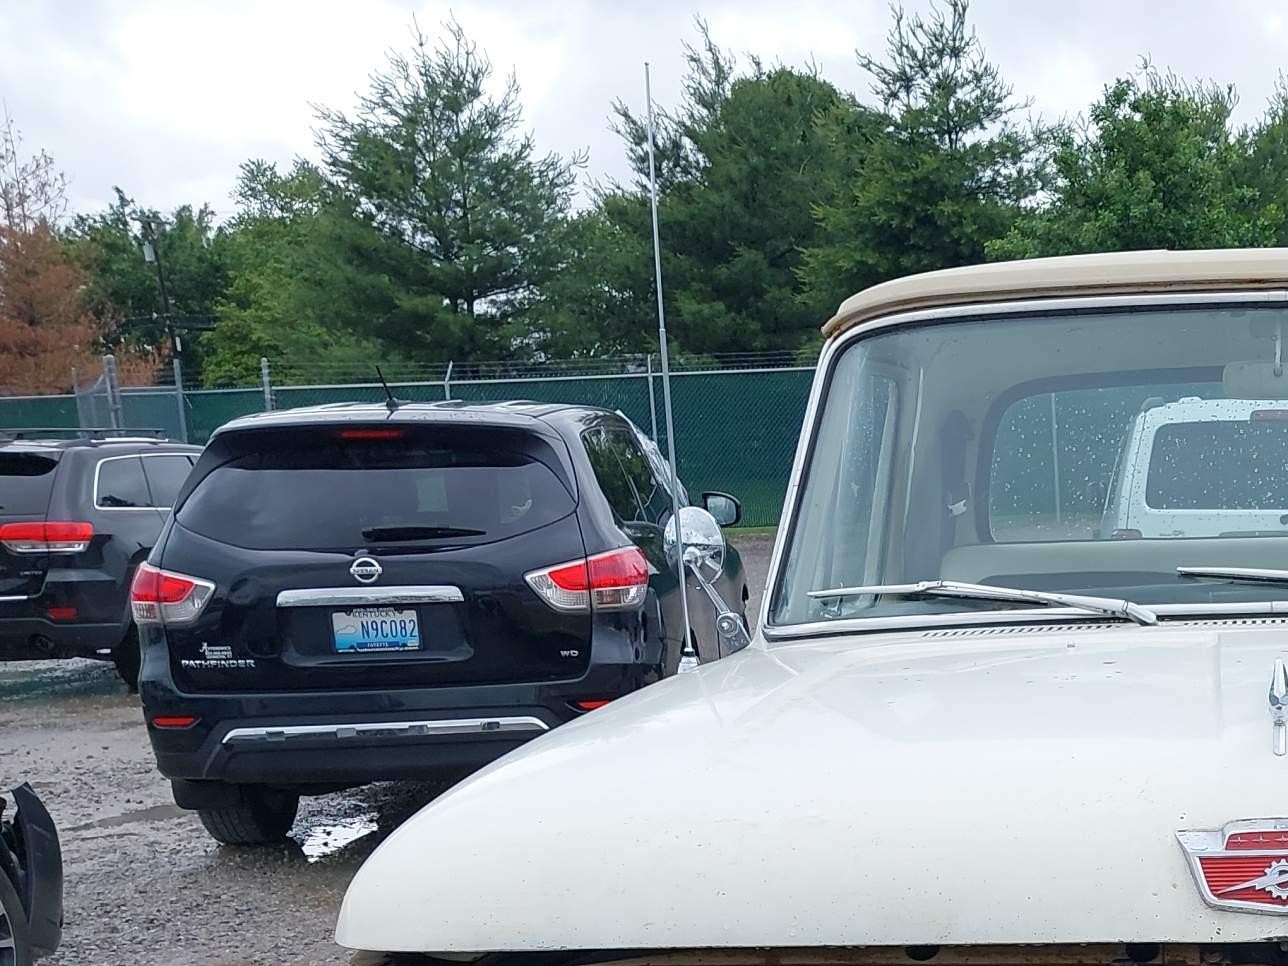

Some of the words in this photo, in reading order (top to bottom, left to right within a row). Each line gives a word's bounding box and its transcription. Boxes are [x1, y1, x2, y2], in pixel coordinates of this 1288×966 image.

[353, 610, 396, 618] KENTUCKY
[361, 619, 417, 640] N9C082
[181, 660, 256, 668] PATHFINDER
